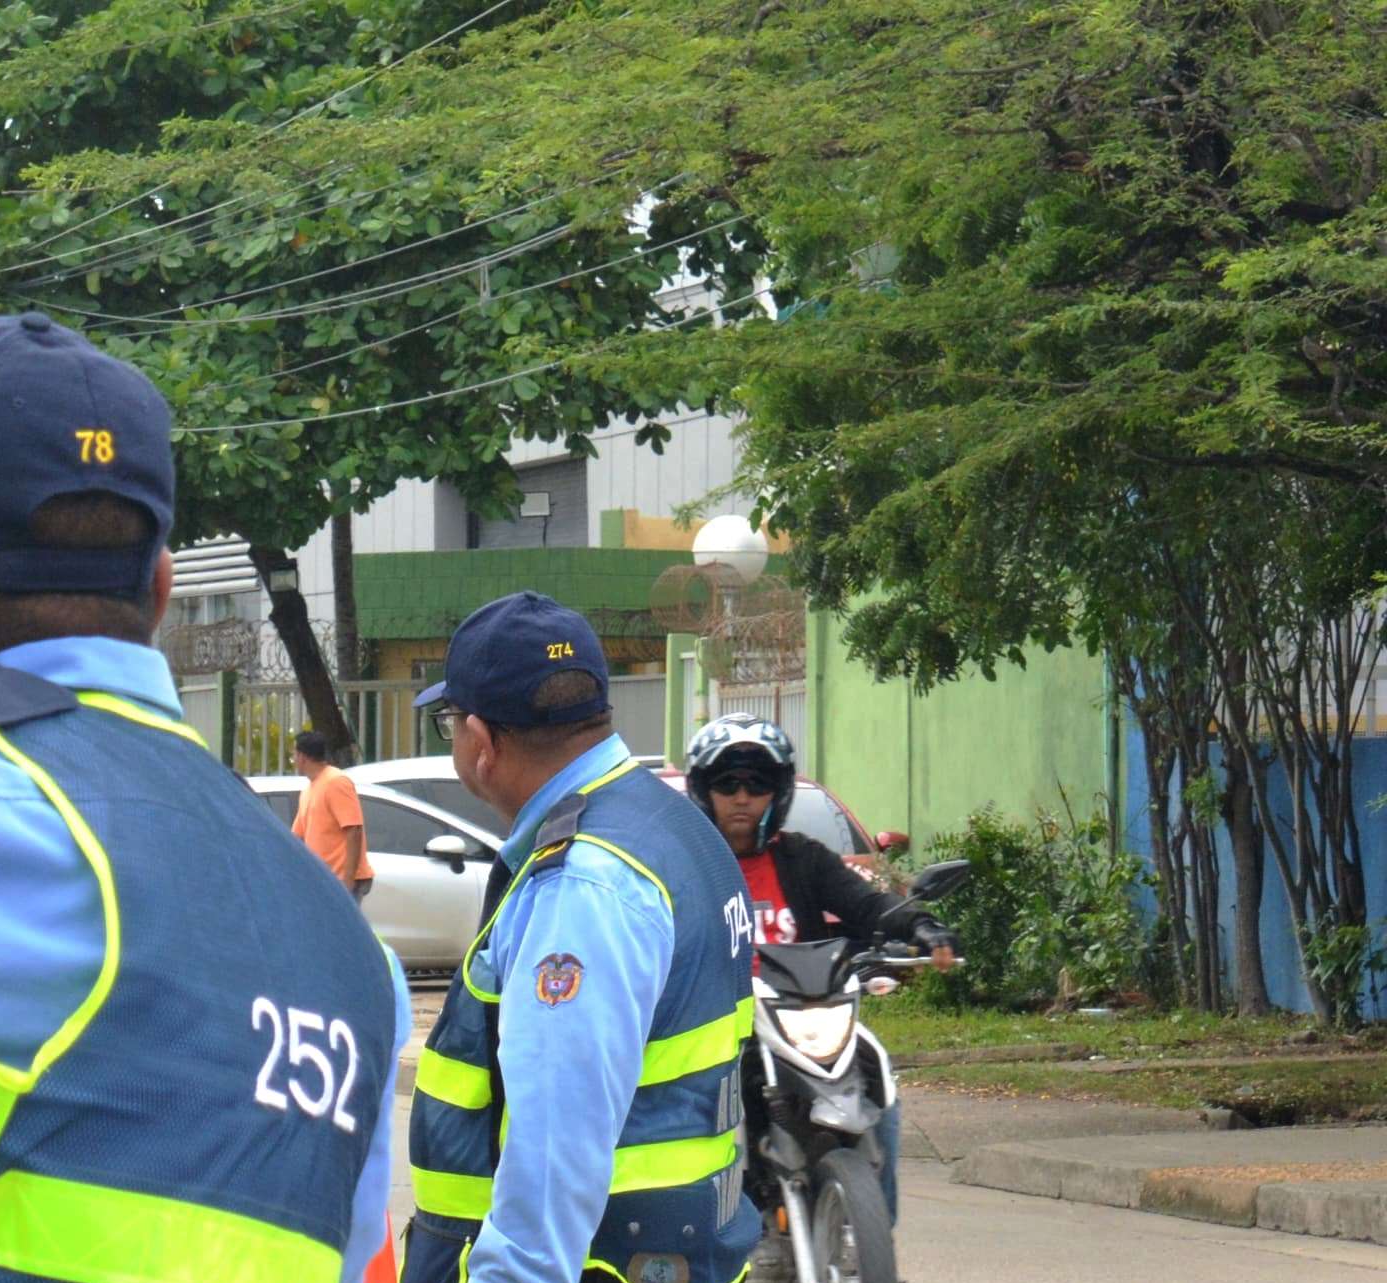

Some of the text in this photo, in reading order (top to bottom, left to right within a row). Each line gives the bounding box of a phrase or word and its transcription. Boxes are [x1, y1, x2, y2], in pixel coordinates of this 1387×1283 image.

[75, 430, 115, 464] 78
[546, 642, 574, 659] 274
[251, 996, 358, 1132] 252
